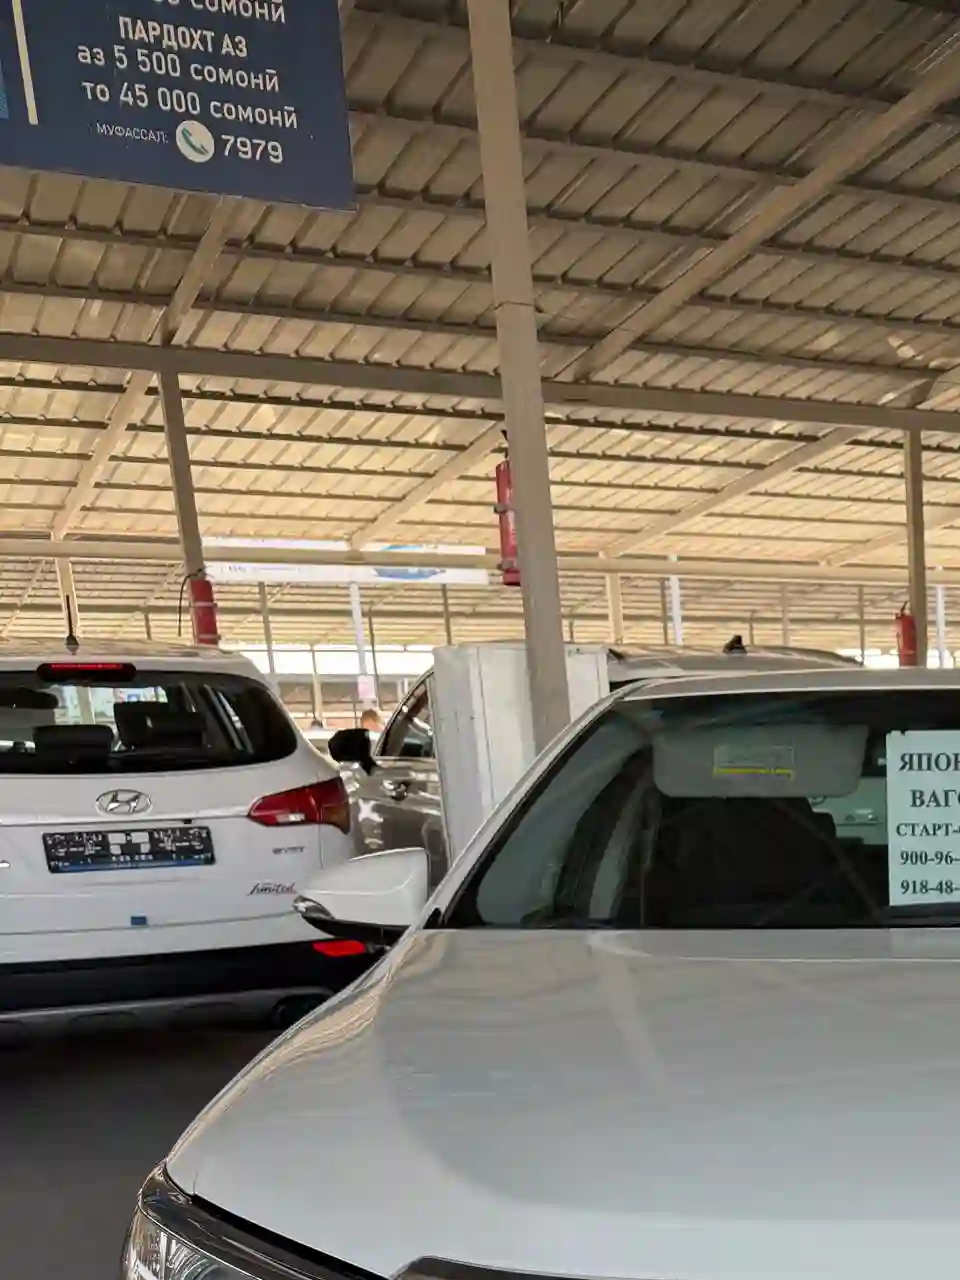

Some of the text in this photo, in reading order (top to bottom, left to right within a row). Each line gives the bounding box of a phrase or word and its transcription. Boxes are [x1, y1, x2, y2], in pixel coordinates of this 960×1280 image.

[118, 16, 248, 58] ПАРДОХТ АЗ
[77, 45, 105, 66] аз
[113, 44, 128, 69] 5
[137, 48, 180, 77] 500
[81, 82, 110, 102] то
[119, 82, 148, 108] 45
[157, 87, 201, 115] 000
[96, 121, 283, 163] МУФАССАЛ: 7979
